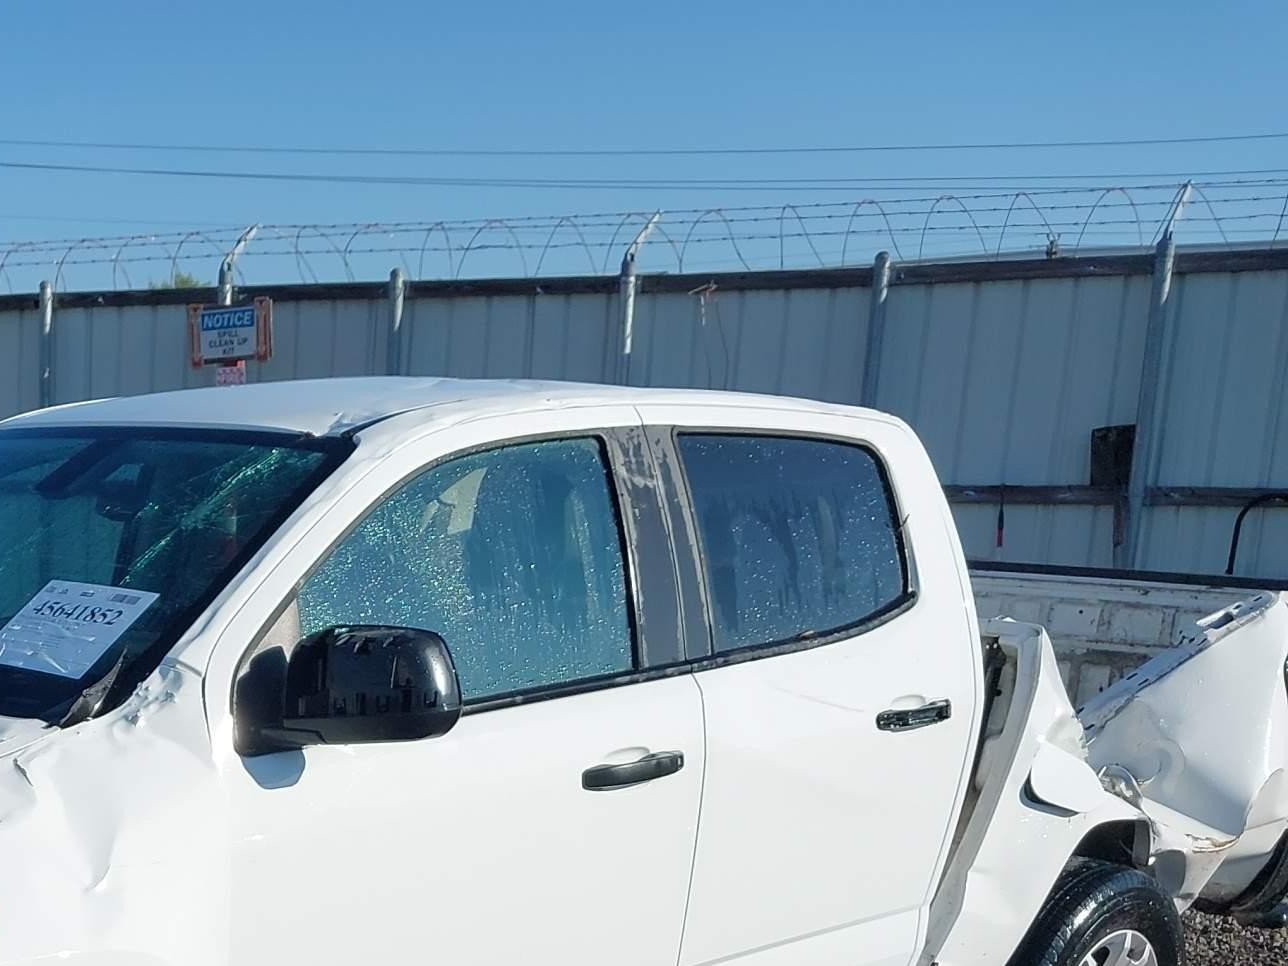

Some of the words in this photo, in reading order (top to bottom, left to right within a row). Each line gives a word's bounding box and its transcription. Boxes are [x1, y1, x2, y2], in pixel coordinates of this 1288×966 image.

[203, 311, 253, 329] NOTICE
[208, 339, 235, 349] CLEAN
[237, 337, 249, 346] UP
[33, 600, 123, 625] 45641852
